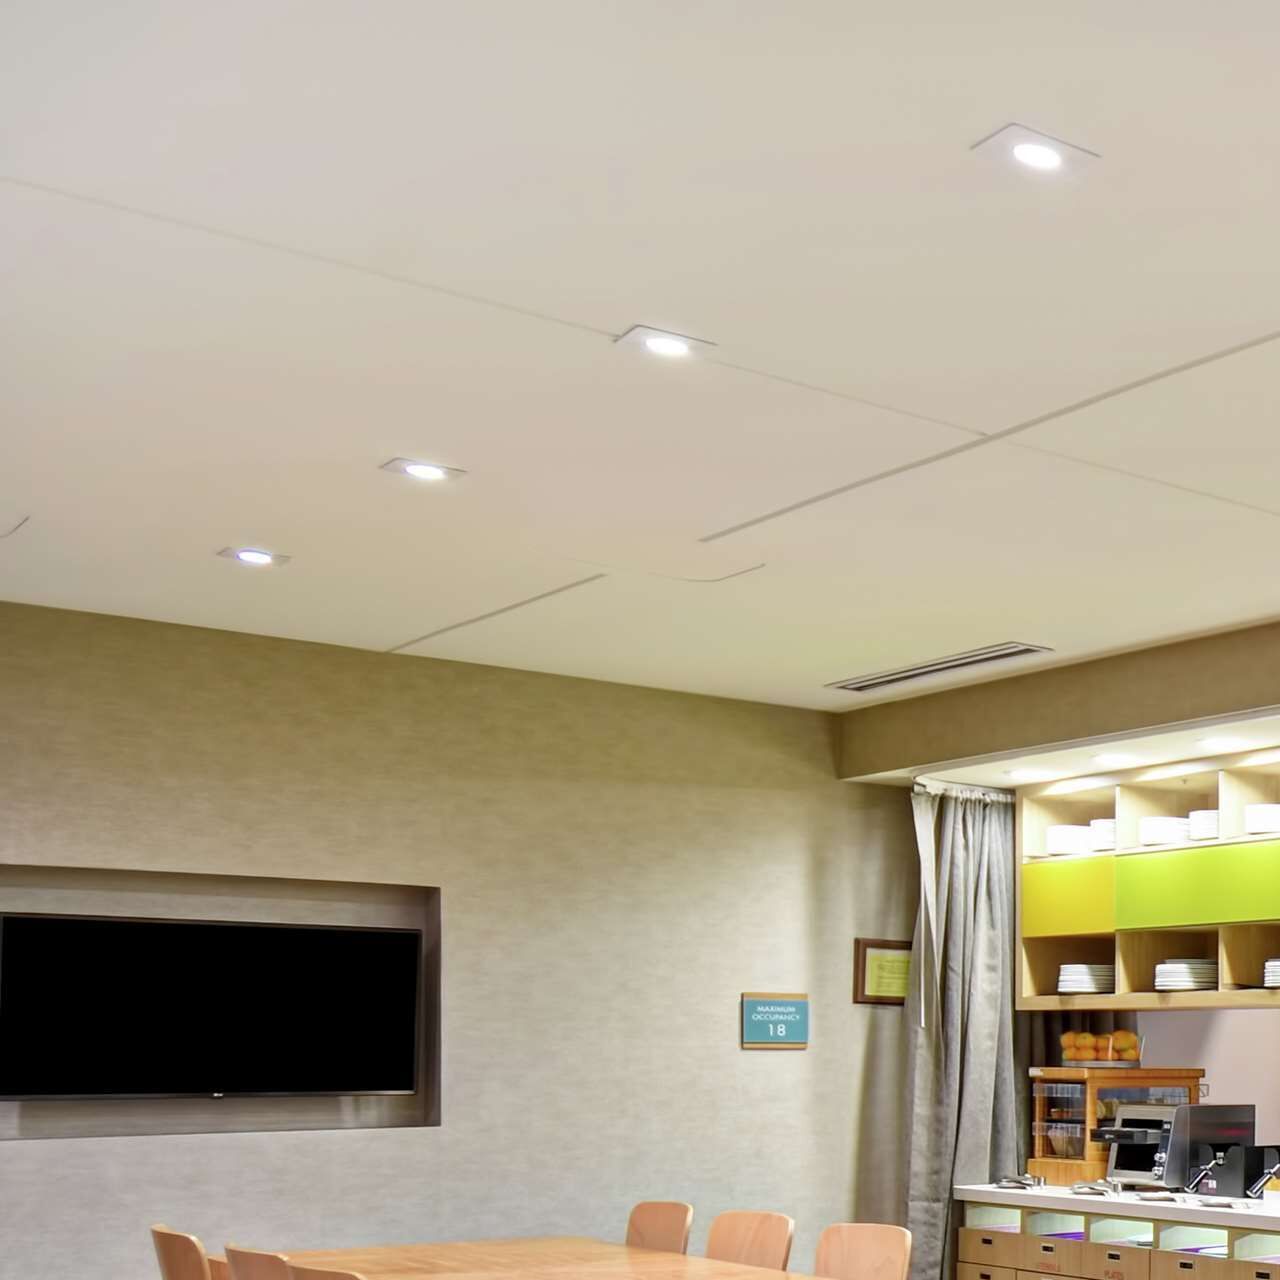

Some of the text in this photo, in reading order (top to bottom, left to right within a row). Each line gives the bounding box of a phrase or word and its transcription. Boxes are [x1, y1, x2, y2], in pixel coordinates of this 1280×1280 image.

[756, 1005, 796, 1013] MAXIMUM
[751, 1013, 800, 1021] OCCUPANCY
[768, 1023, 786, 1037] 18
